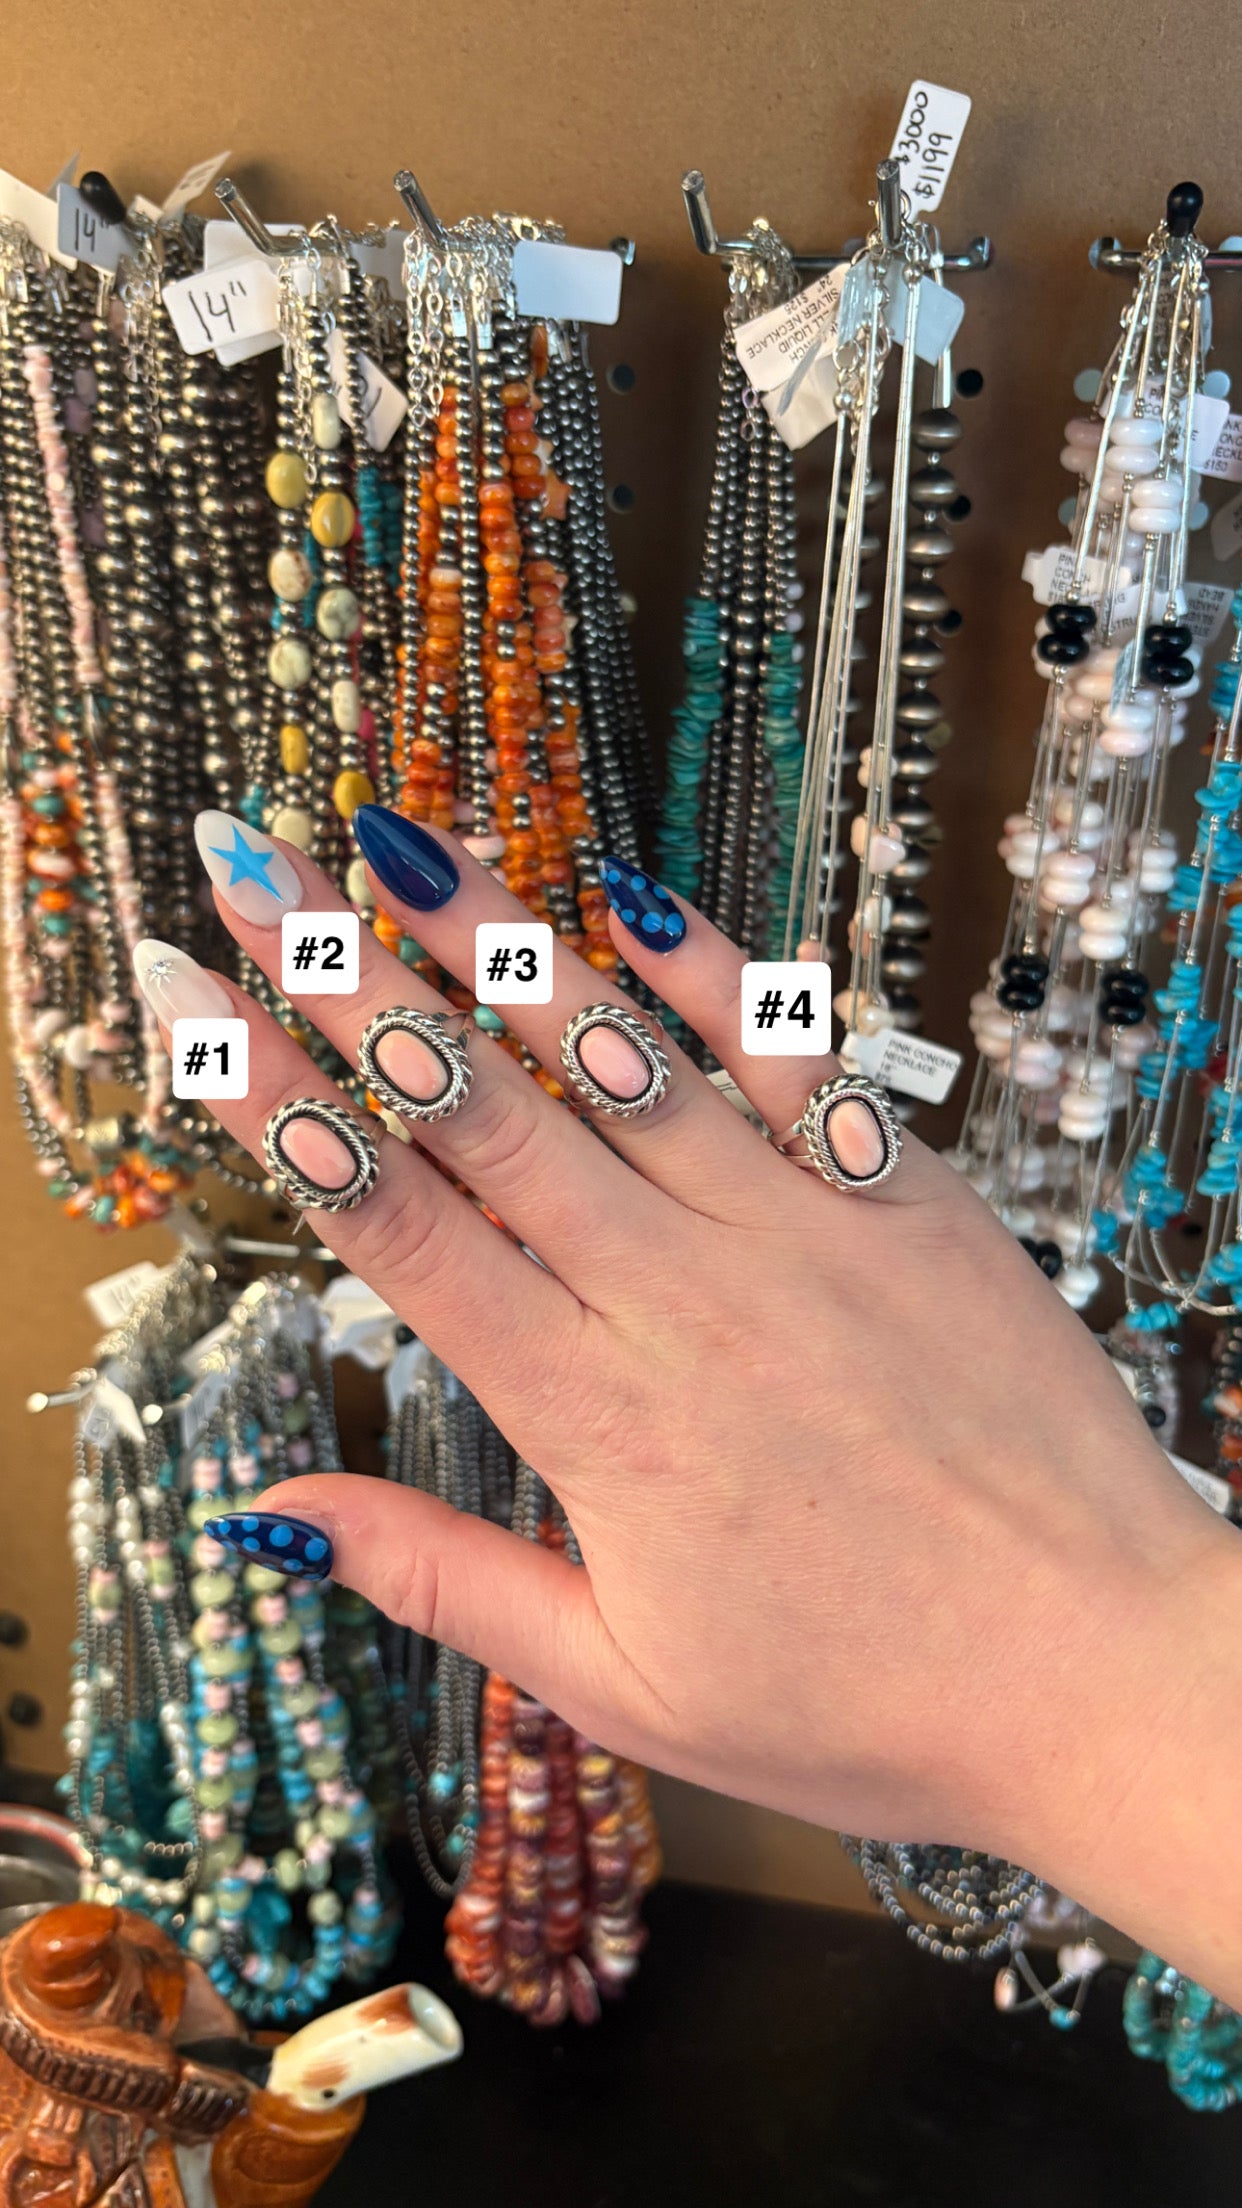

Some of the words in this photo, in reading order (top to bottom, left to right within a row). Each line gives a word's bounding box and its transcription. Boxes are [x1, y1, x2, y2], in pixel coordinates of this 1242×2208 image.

[894, 91, 928, 165] $3000
[912, 133, 953, 199] $1199
[188, 281, 247, 342] 14"
[801, 288, 839, 319] SILVER
[745, 314, 801, 359] NECKLACE
[778, 324, 813, 354] LIQUID
[884, 1050, 935, 1077] NECKLACE
